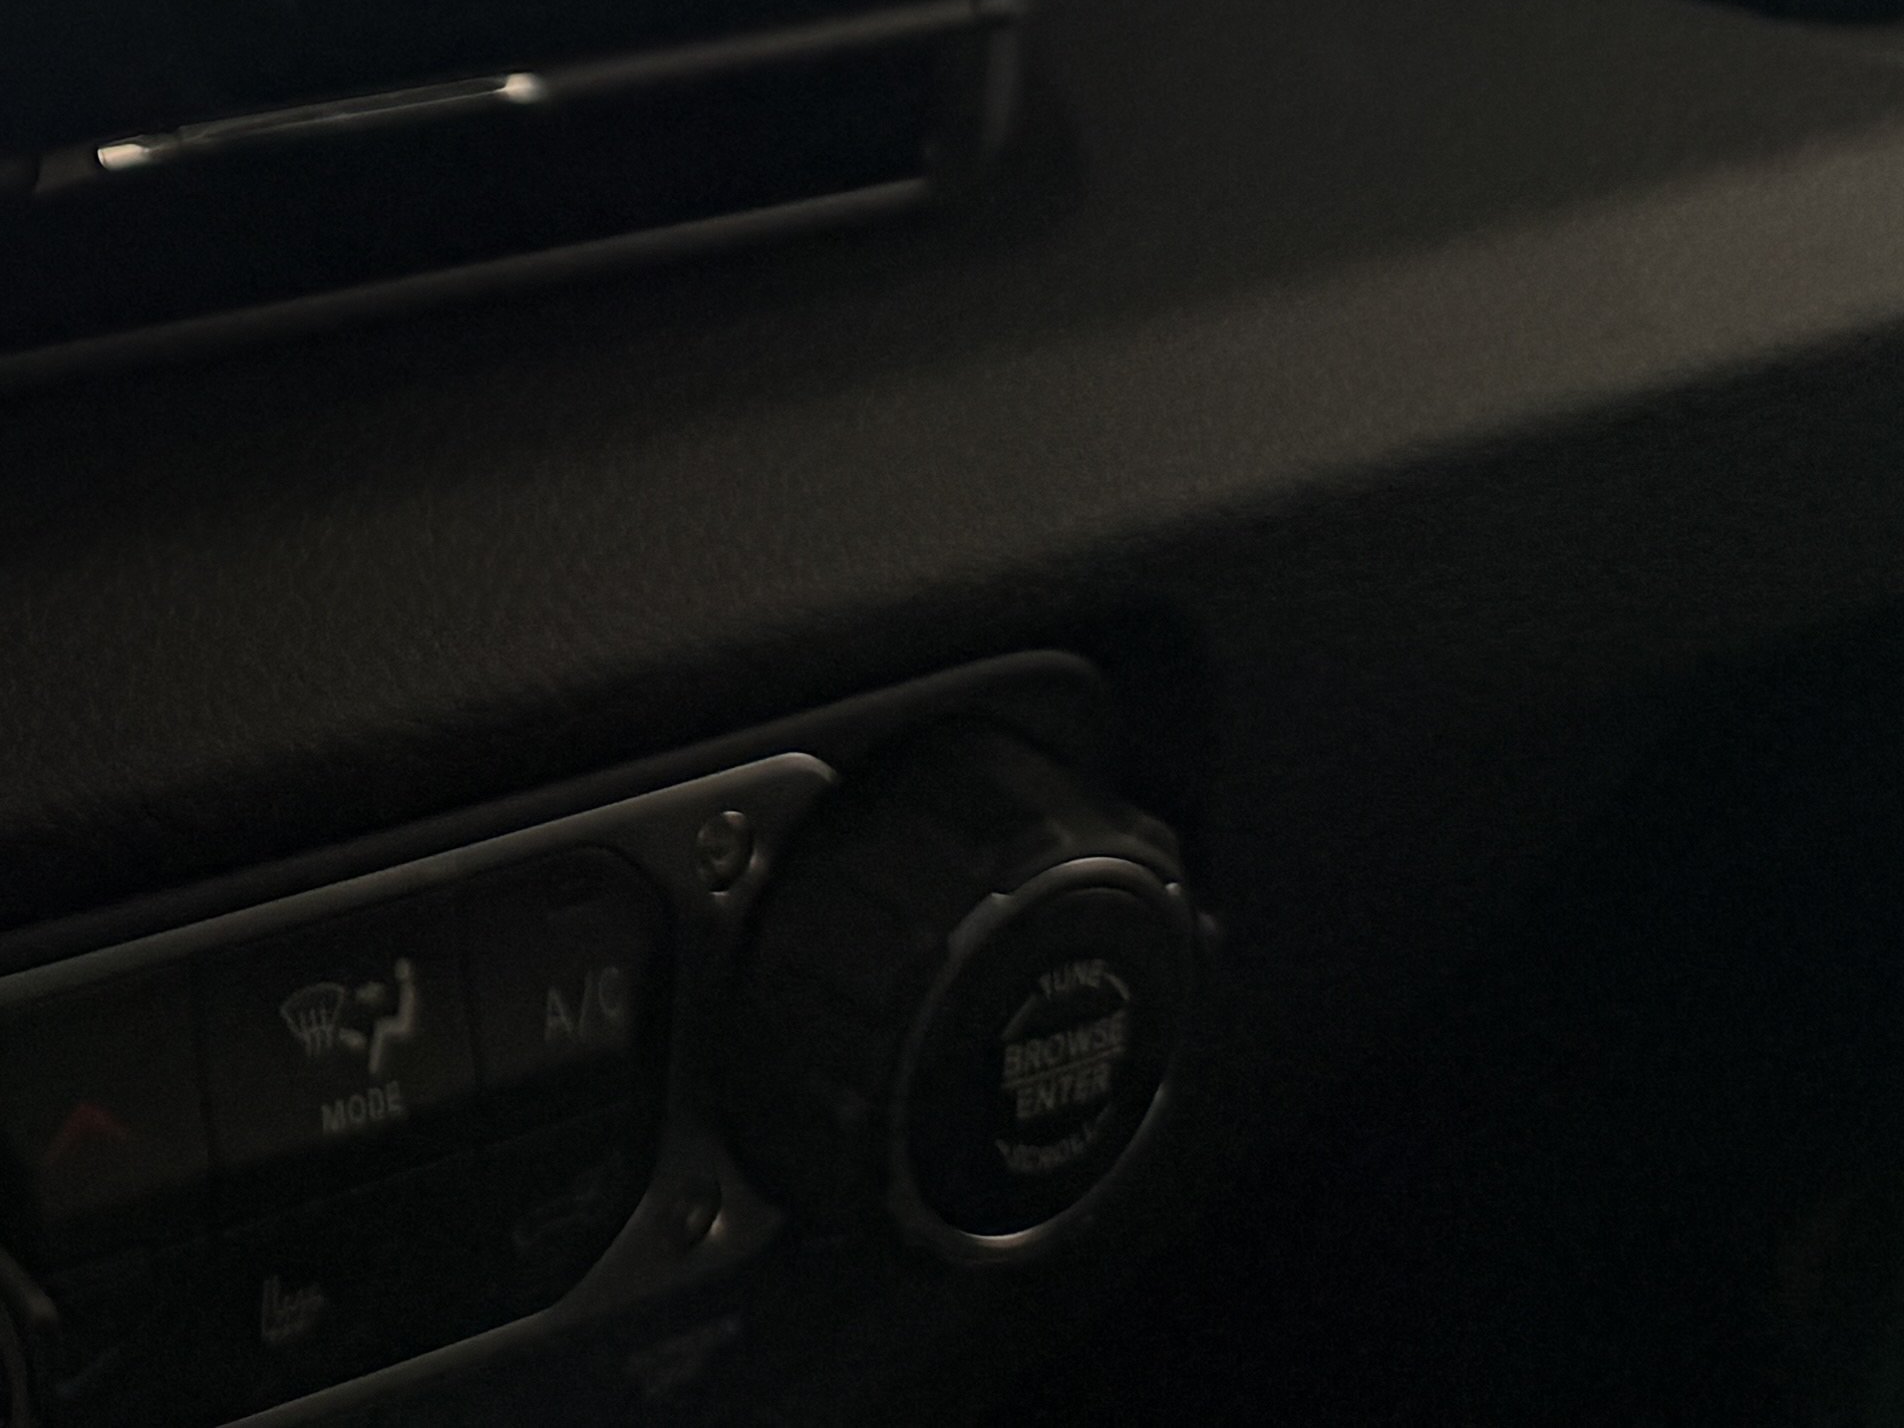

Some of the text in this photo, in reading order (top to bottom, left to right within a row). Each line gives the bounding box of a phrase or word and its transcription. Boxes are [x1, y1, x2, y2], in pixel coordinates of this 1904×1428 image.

[545, 965, 625, 1043] A/C
[1039, 958, 1105, 1000] TUNE
[1002, 1009, 1128, 1080] BROWSE
[321, 1080, 405, 1134] MODE
[1016, 1062, 1111, 1120] ENTER
